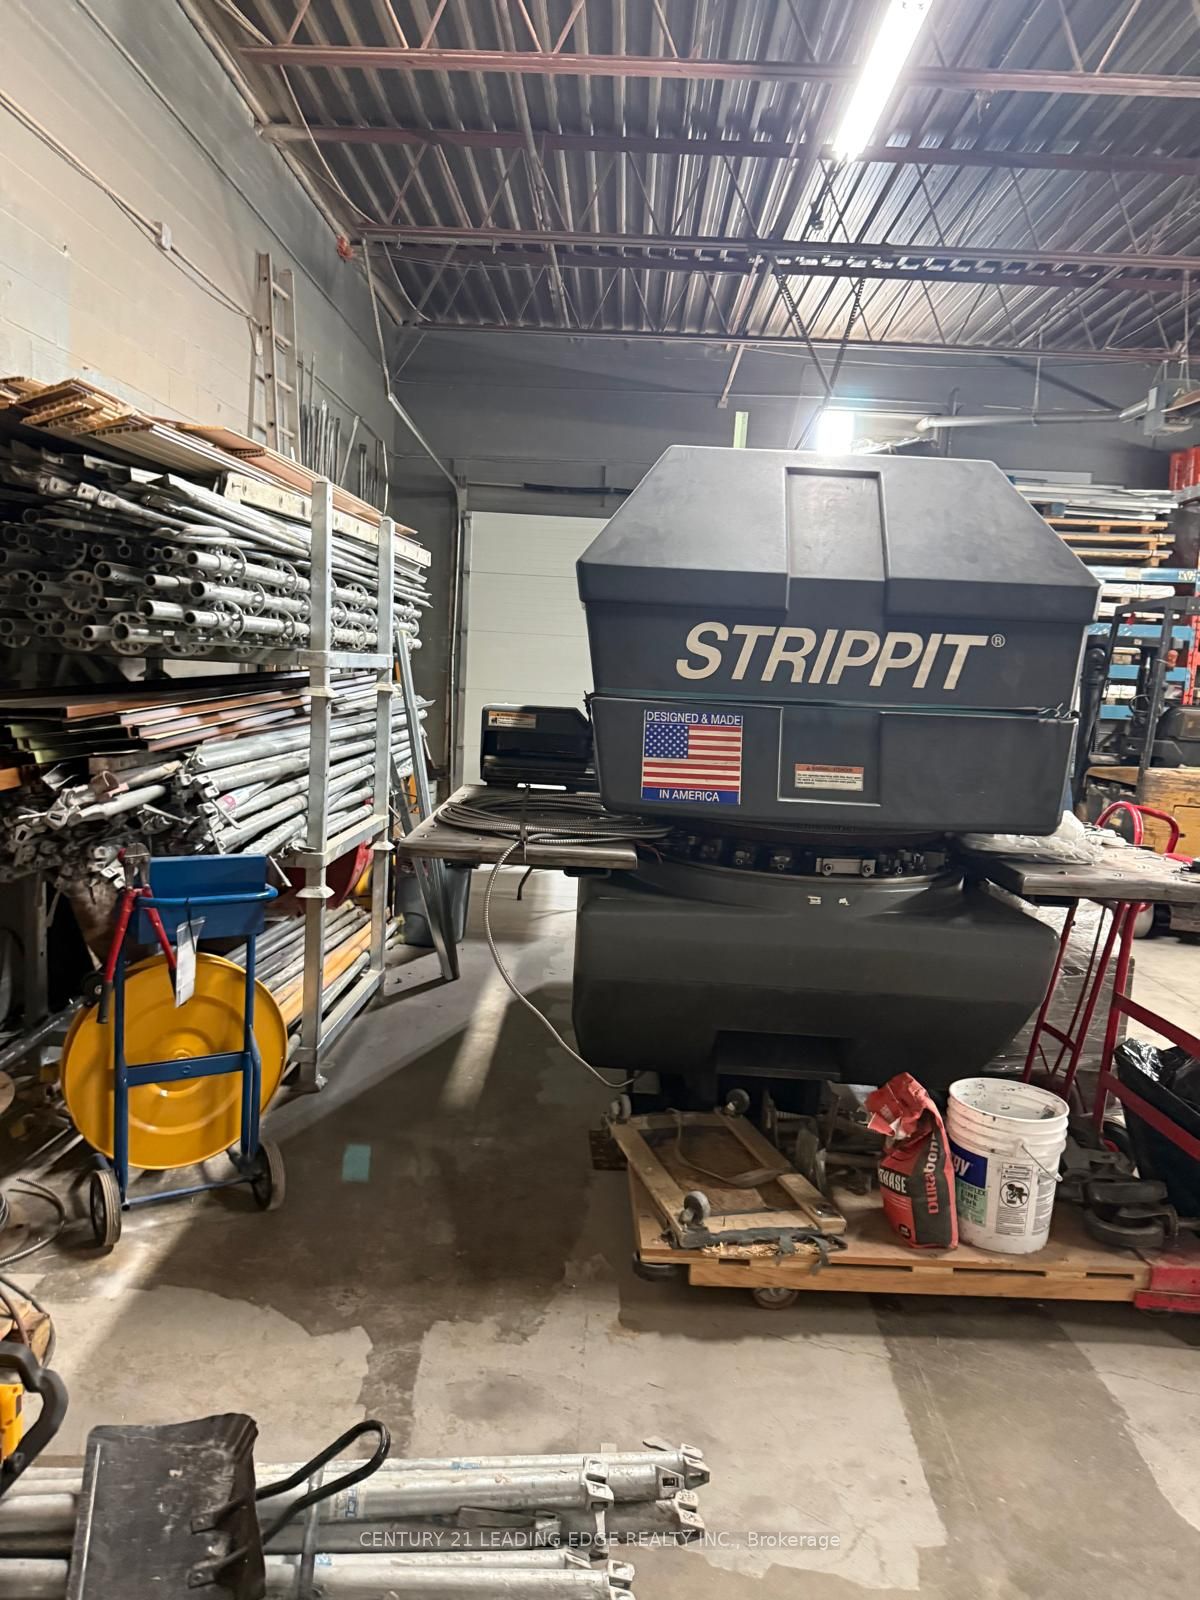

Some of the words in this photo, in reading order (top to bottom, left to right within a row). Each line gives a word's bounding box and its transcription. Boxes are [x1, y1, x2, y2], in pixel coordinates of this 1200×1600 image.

[646, 711, 699, 724] DESIGNED
[701, 713, 709, 724] &
[711, 714, 741, 726] MADE
[659, 789, 670, 799] IN
[672, 789, 720, 802] AMERICA
